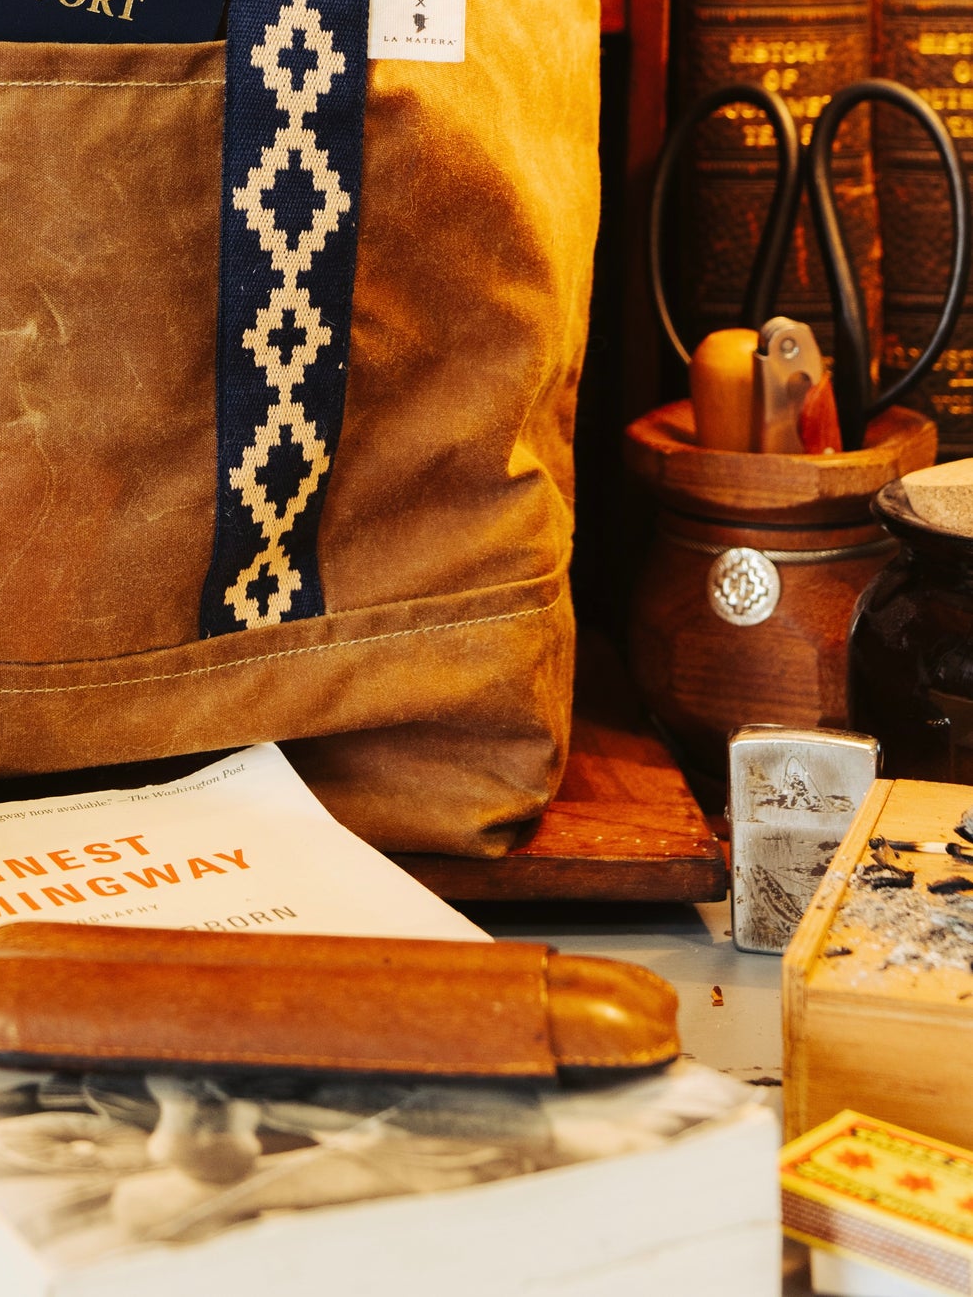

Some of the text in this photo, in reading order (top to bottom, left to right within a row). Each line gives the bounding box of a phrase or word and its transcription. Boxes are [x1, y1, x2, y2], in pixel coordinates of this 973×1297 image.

[29, 808, 54, 817] now
[152, 775, 220, 799] Washington
[222, 763, 246, 779] Post
[180, 905, 298, 932] BORN
